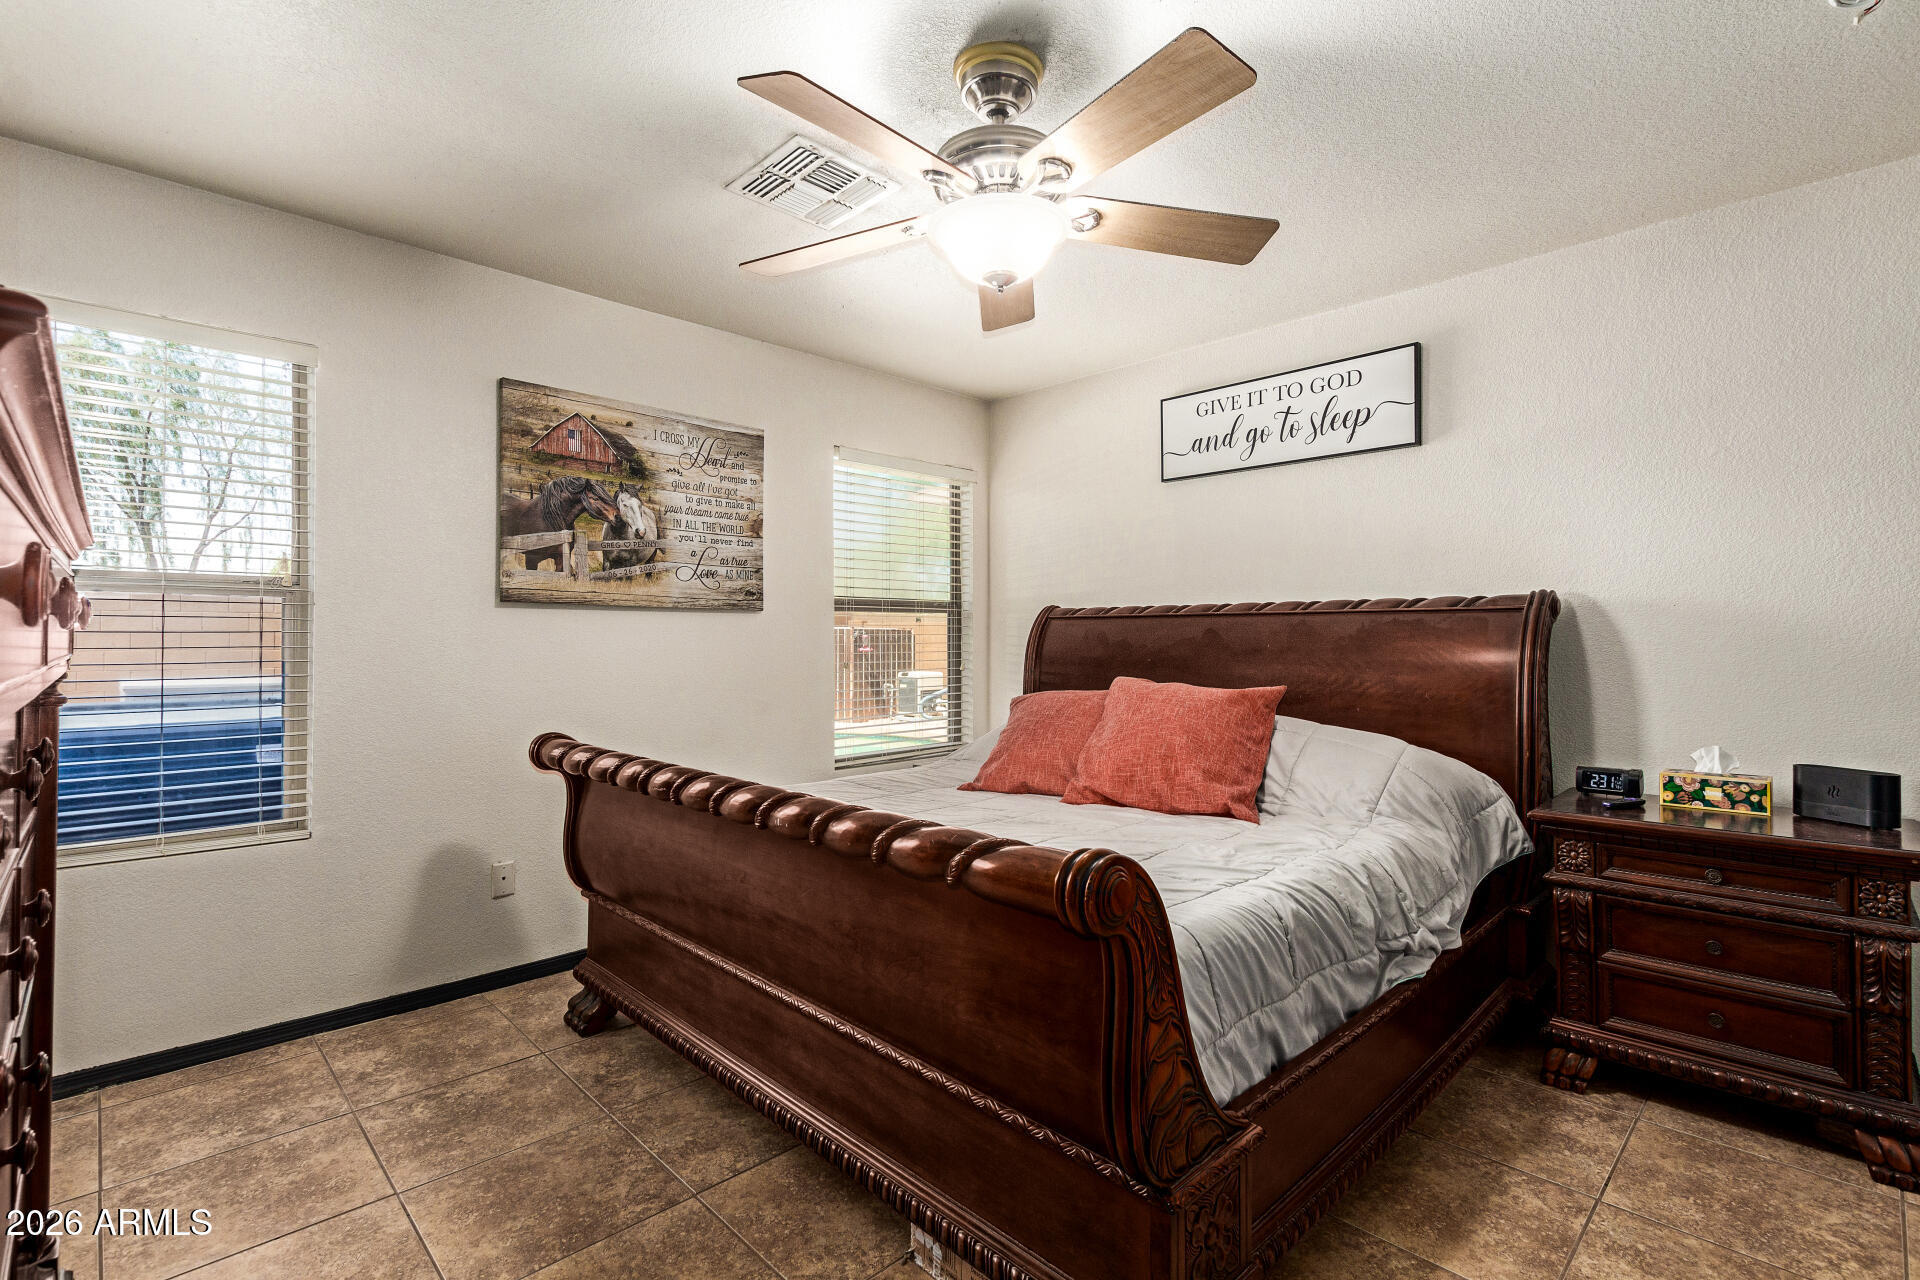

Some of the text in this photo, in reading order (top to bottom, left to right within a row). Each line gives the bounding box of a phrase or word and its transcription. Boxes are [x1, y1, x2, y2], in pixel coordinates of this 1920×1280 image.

[1196, 369, 1362, 417] GIVE IT TO GOD
[1190, 395, 1374, 461] and go to sleep
[654, 430, 700, 448] I CROSS MY
[679, 437, 732, 477] Heart
[720, 475, 748, 484] promise
[672, 480, 690, 492] give
[692, 482, 704, 492] all
[724, 487, 738, 498] got
[686, 495, 756, 510] to give to make all
[664, 505, 749, 521] your dreams come true
[673, 519, 744, 534] IN ALL THE WORLD
[678, 534, 707, 543] you'll
[736, 538, 754, 547] find
[676, 546, 754, 590] Love AS MINE
[731, 556, 748, 566] true
